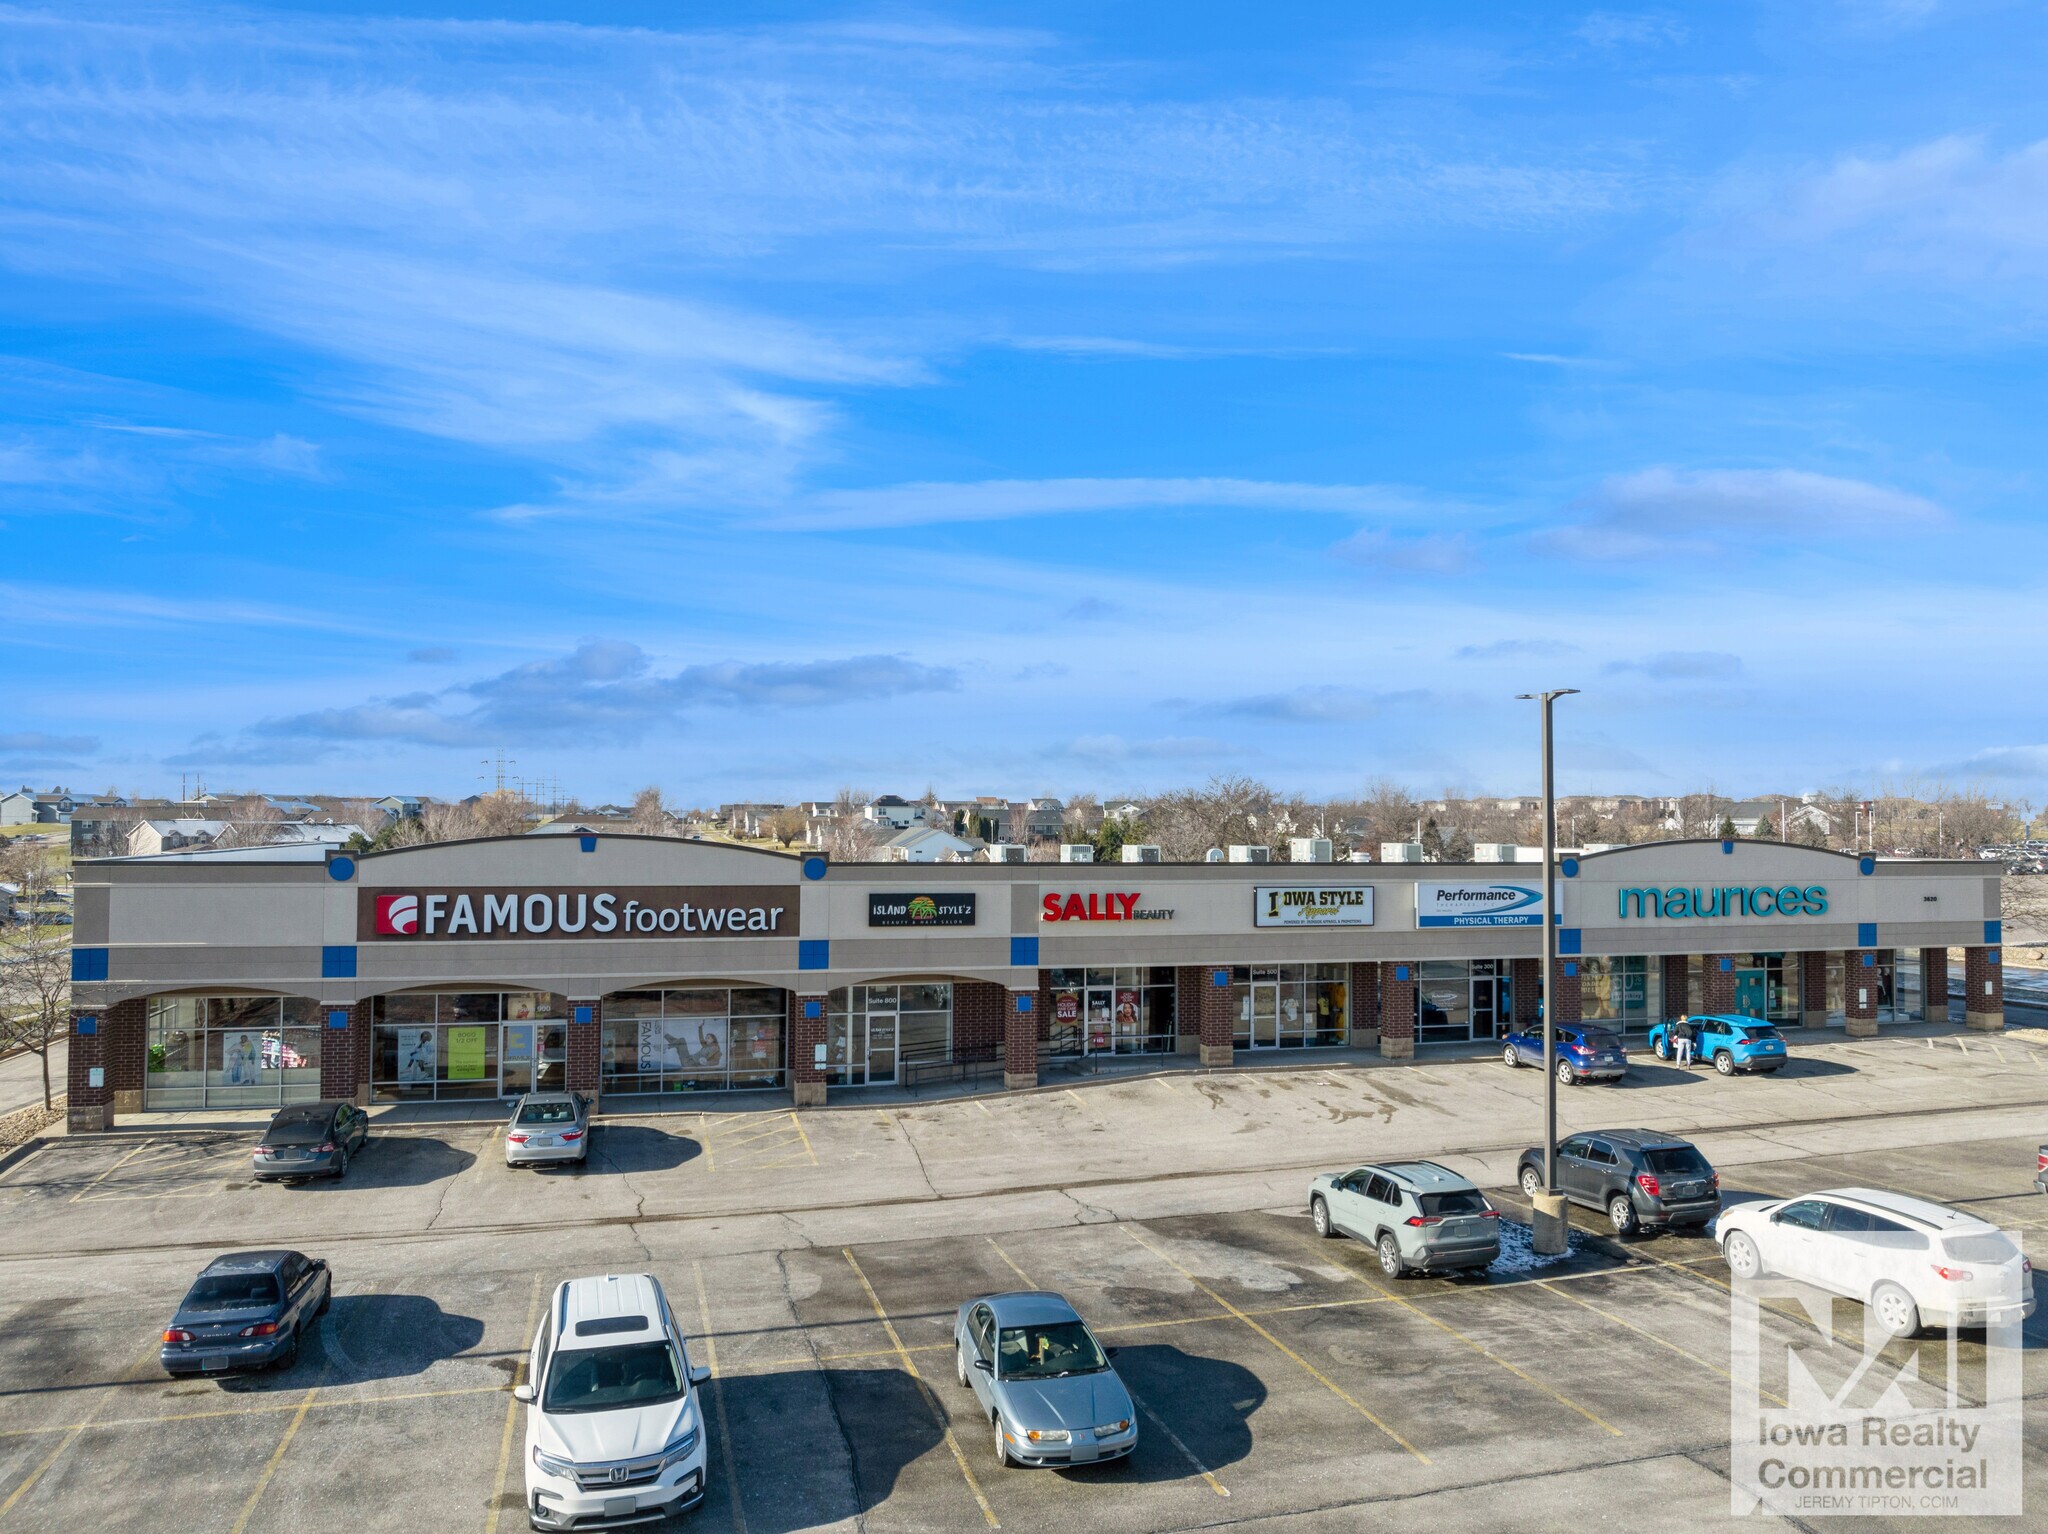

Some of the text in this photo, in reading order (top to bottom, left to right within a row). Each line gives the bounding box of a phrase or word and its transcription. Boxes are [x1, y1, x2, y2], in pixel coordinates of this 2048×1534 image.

[1043, 893, 1175, 921] SALLY BEAUTY
[1268, 891, 1364, 917] IOWA STYLE
[1437, 889, 1516, 901] Performance
[1618, 885, 1828, 918] maurices
[425, 893, 784, 933] FAMOUS footwear
[1298, 904, 1341, 919] Apparel
[1453, 916, 1529, 925] PHYSICAL THERAPY
[640, 1021, 652, 1070] FAMOUS
